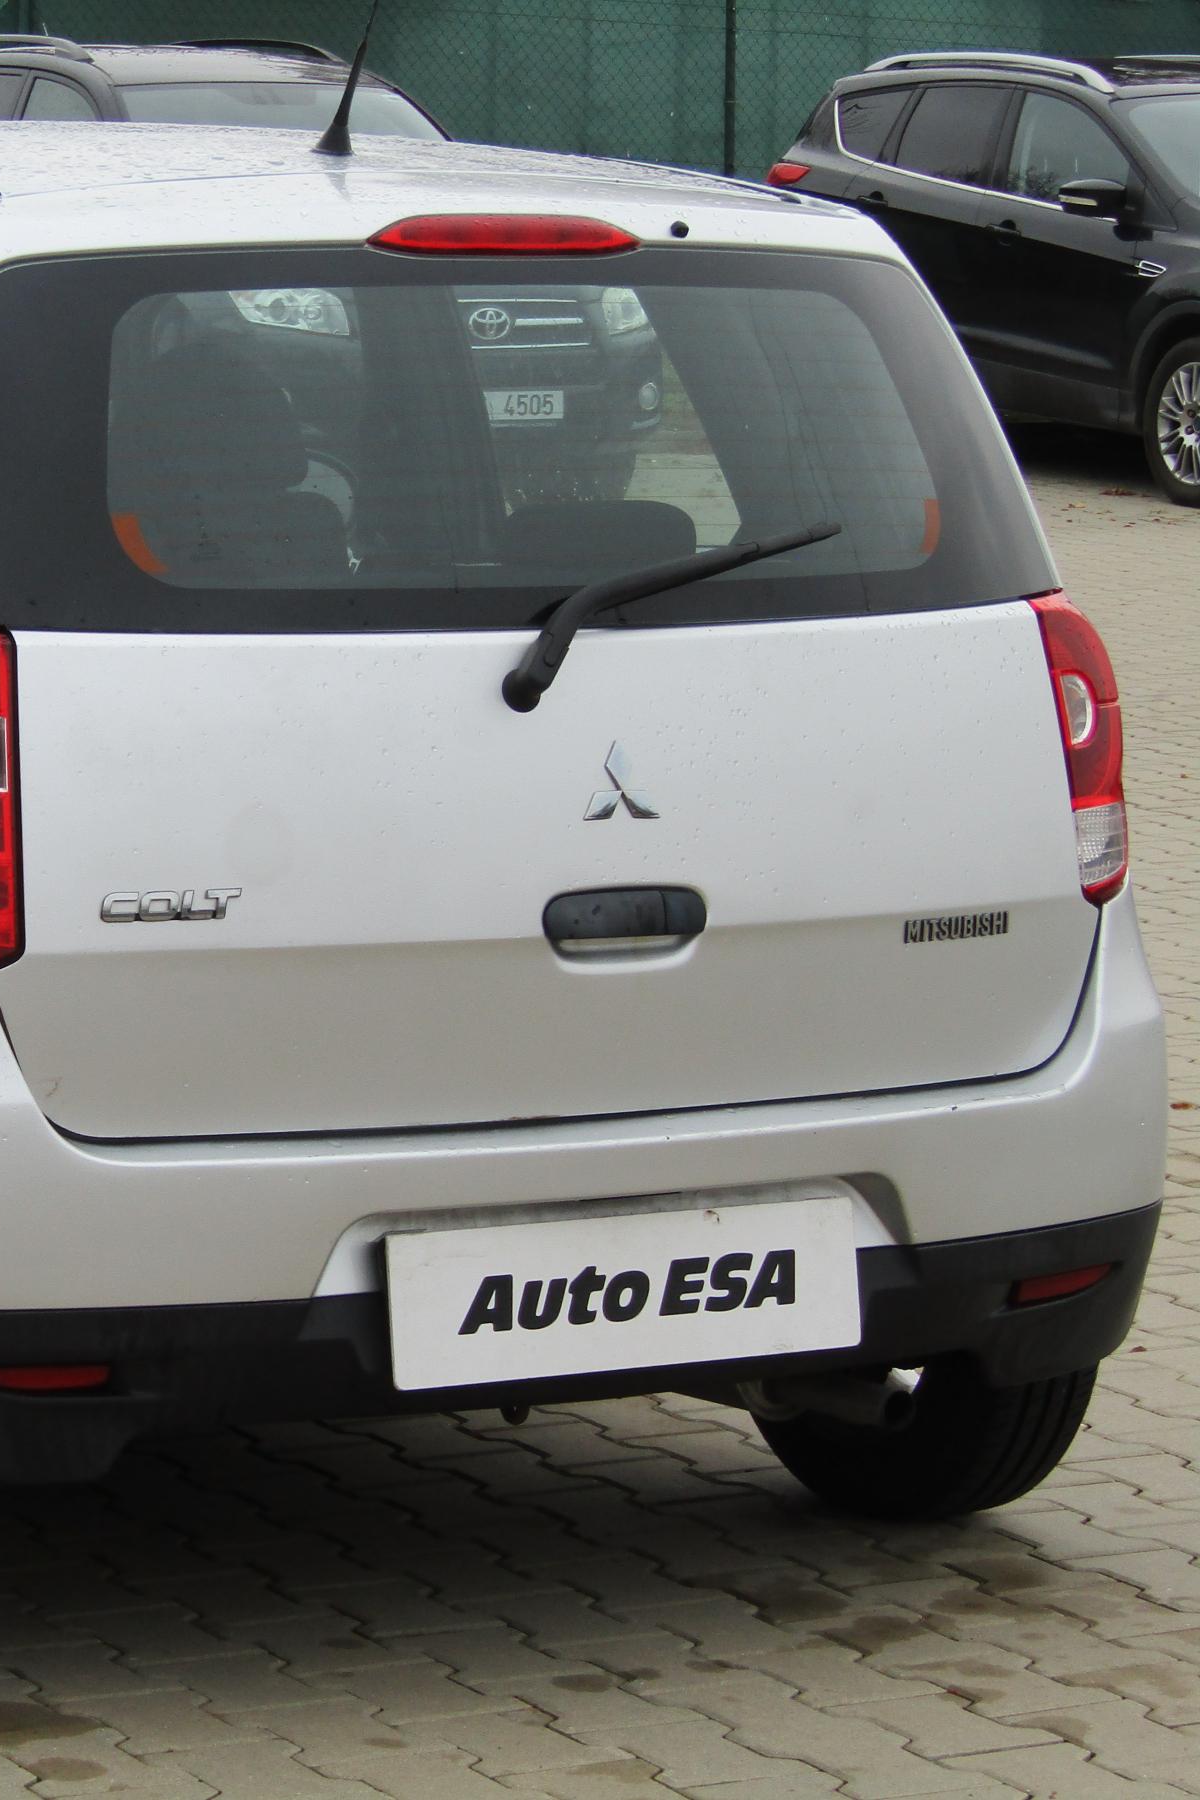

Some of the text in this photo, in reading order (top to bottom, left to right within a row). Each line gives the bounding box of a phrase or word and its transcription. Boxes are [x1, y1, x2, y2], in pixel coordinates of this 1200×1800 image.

[504, 393, 554, 416] 4505
[101, 887, 242, 923] COLT
[458, 1249, 796, 1335] Auto ESA
